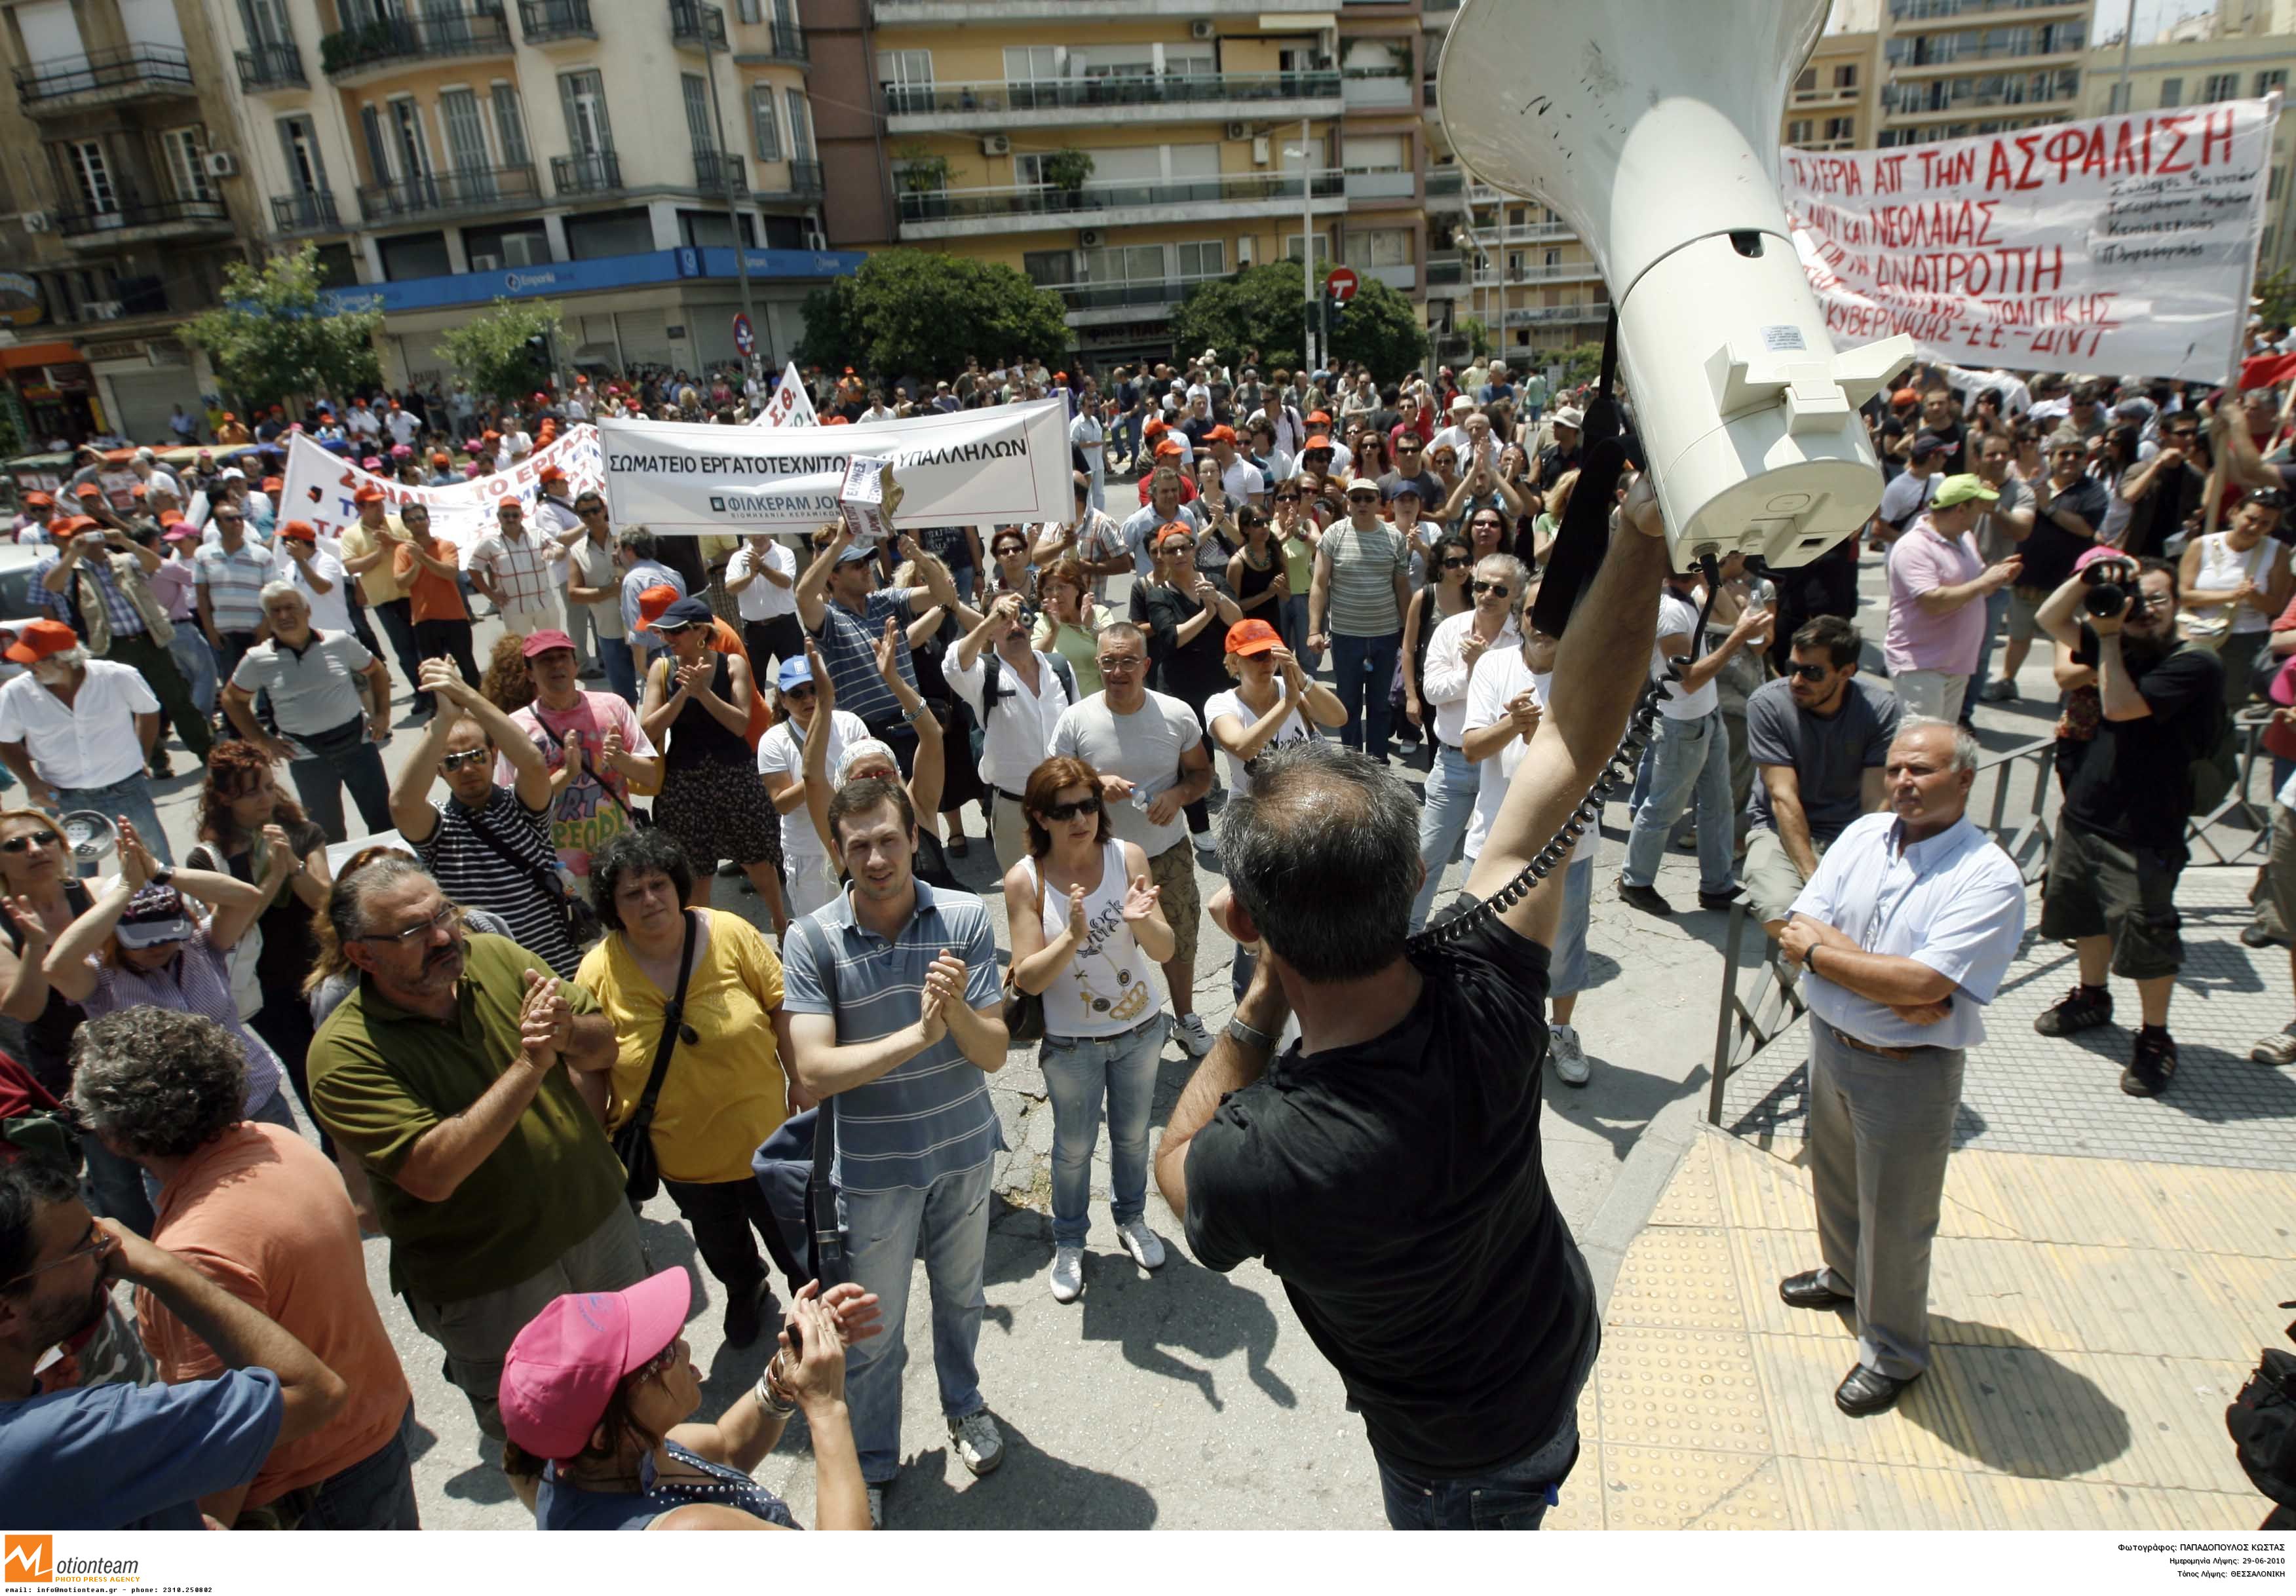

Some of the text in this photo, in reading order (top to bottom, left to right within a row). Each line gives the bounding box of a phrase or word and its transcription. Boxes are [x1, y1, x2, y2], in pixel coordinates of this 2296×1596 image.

[1809, 157, 1862, 197] ΧΕΡΙΑ
[1917, 147, 1975, 189] ΤΗΝ
[1985, 108, 2234, 192] ΑΣΦΑΛΙΣΗ
[1844, 217, 1867, 246] ΚΑΙ
[1876, 243, 2063, 297] ΑΝΑΤΡΟΠΗ
[1981, 292, 2122, 328] ΠΟΛΙΤΙΚΗΣ
[609, 455, 697, 473] ΣΩΜΑΤΕΙΟ
[900, 438, 1027, 467] ΥΠΑΛΛΗΛΩΝ
[728, 495, 811, 512] ΦΙΛΚΕΡΑΜ
